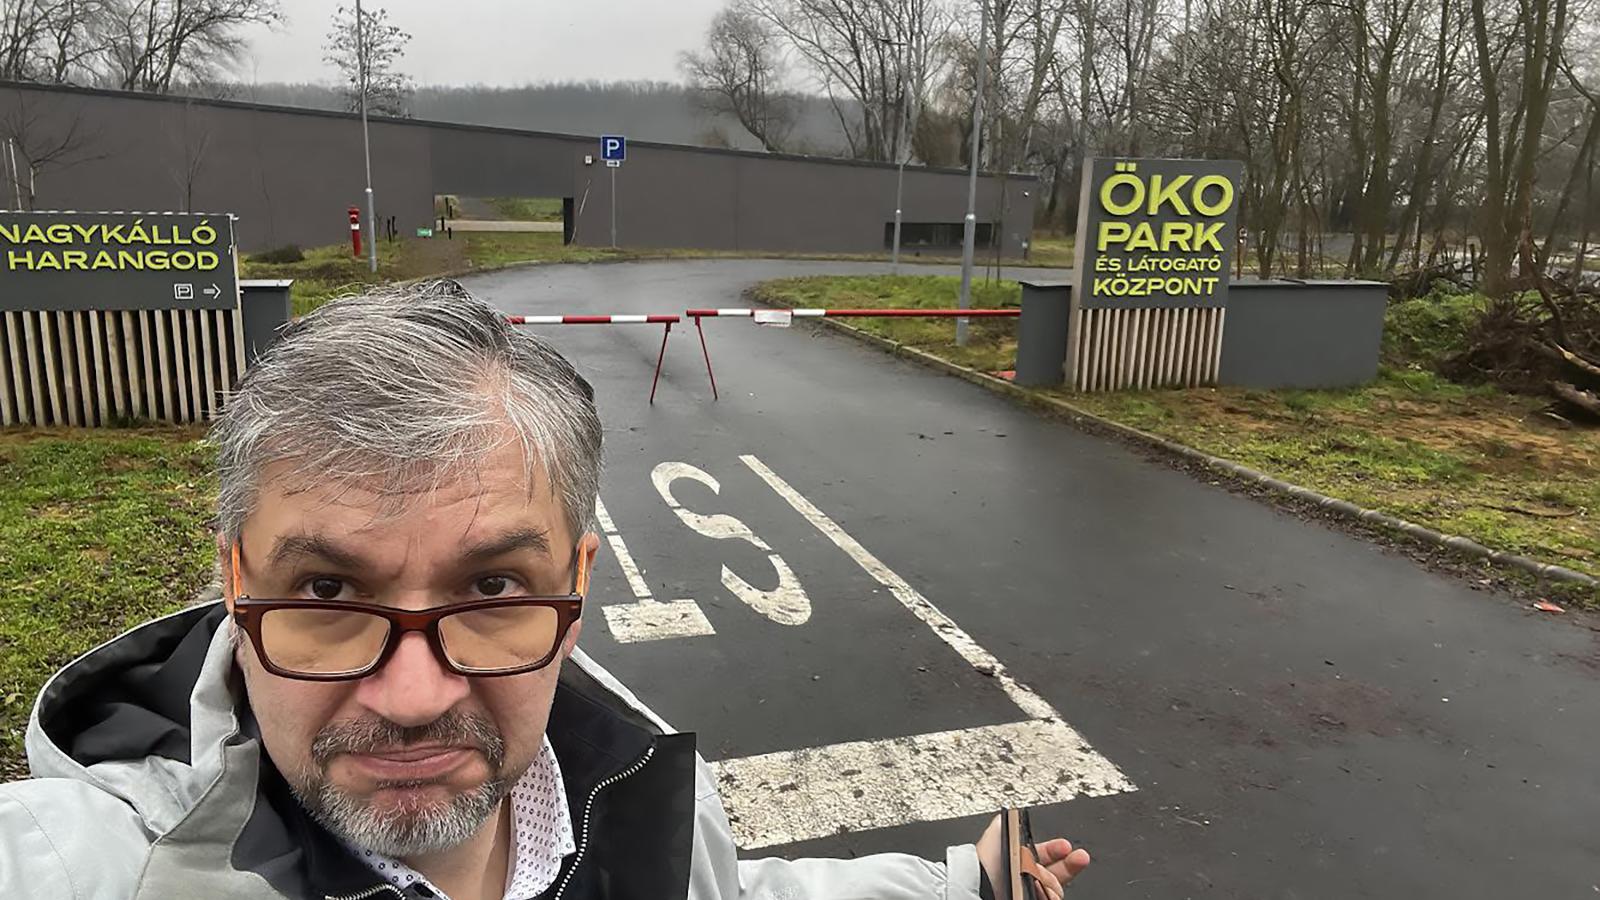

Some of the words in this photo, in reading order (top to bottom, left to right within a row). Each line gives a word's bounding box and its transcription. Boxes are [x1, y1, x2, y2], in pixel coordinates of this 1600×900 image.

[606, 139, 620, 157] P
[1100, 162, 1234, 216] ÖKO
[0, 219, 217, 244] NAGYKÁLLÓ
[1097, 222, 1226, 251] PARK
[8, 251, 219, 270] HARANGOD
[1095, 255, 1122, 272] ÉS
[1127, 254, 1222, 272] LÁTOGATÓ
[1092, 273, 1219, 296] KÖZPONT
